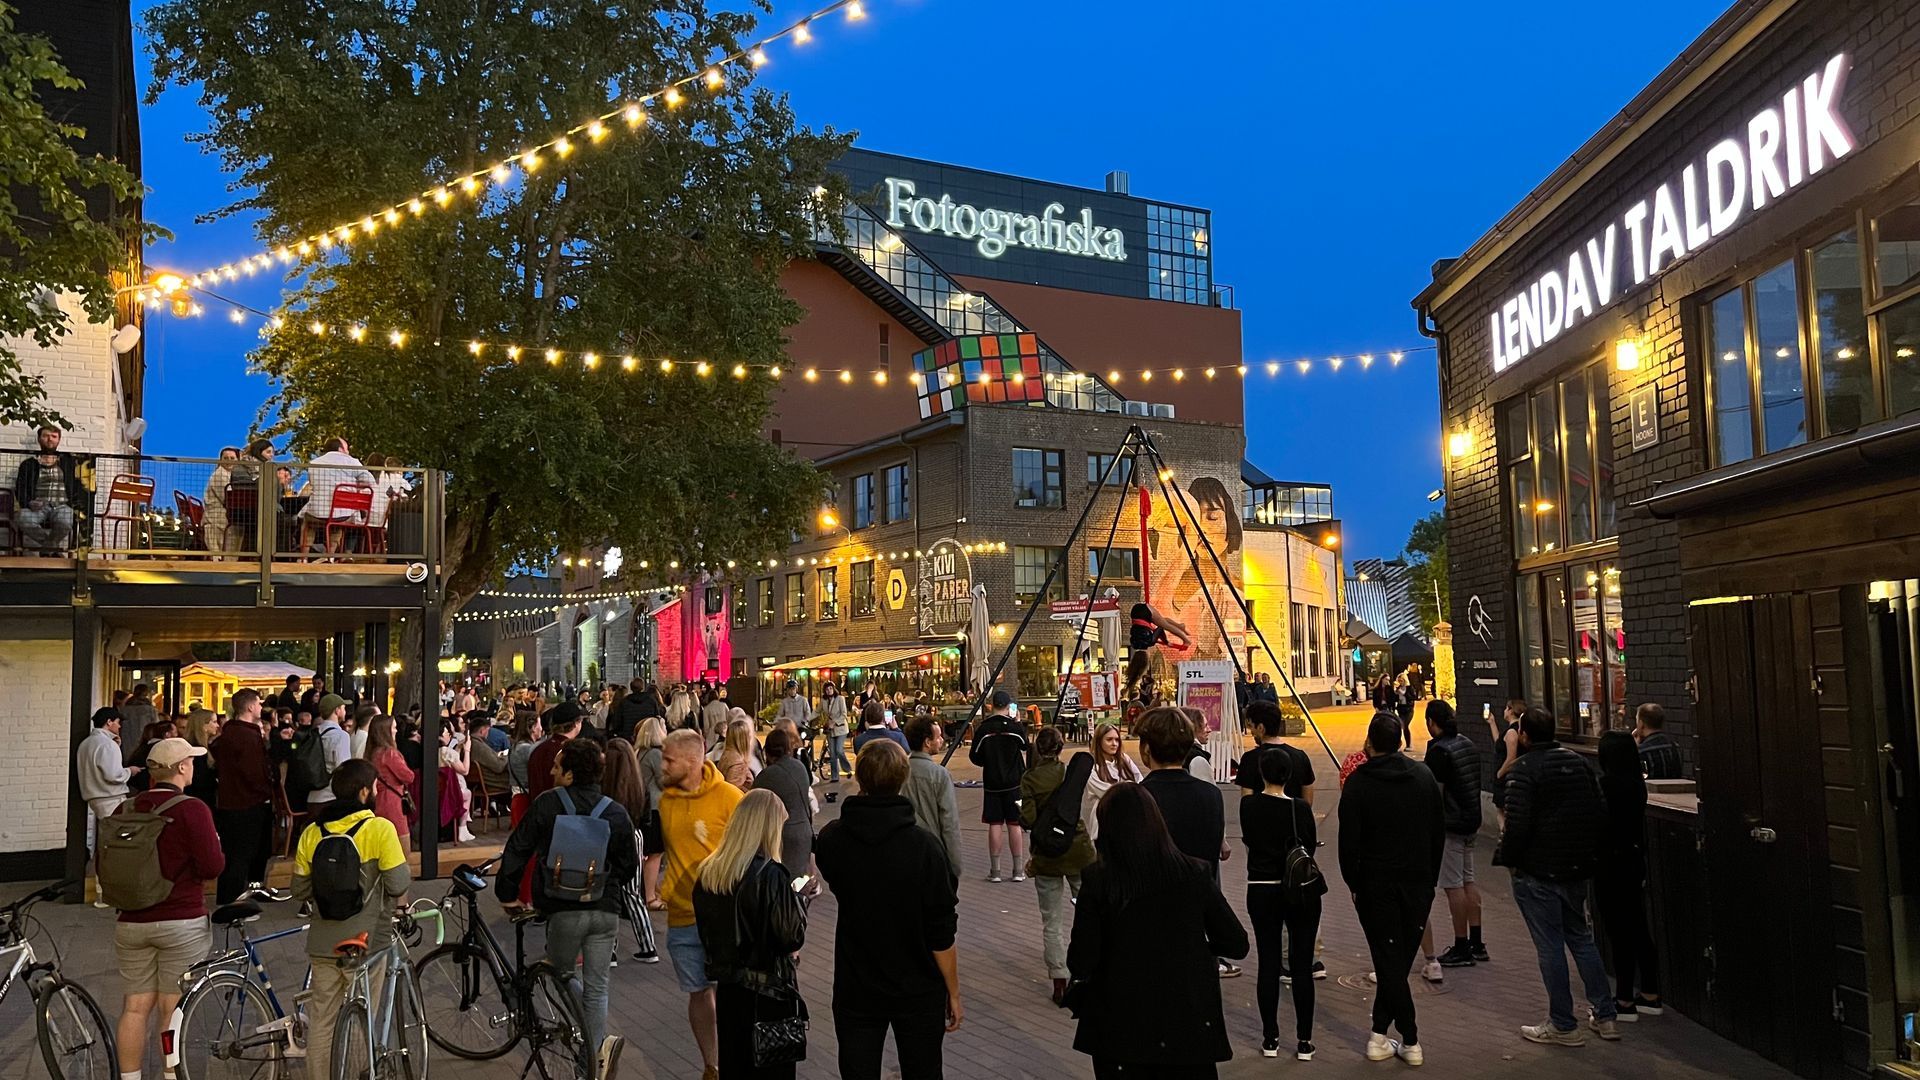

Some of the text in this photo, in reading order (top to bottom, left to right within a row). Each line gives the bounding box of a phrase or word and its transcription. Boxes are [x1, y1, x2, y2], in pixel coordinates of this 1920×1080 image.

[884, 176, 1129, 259] Fotografiska
[1491, 52, 1857, 374] LENDAV TALDRIK
[1639, 401, 1648, 427] E
[1635, 427, 1655, 442] HOONE
[934, 553, 955, 576] KIVI
[893, 579, 902, 601] D
[934, 578, 970, 601] PABER
[934, 603, 972, 624] KAARID
[1186, 670, 1204, 679] STL
